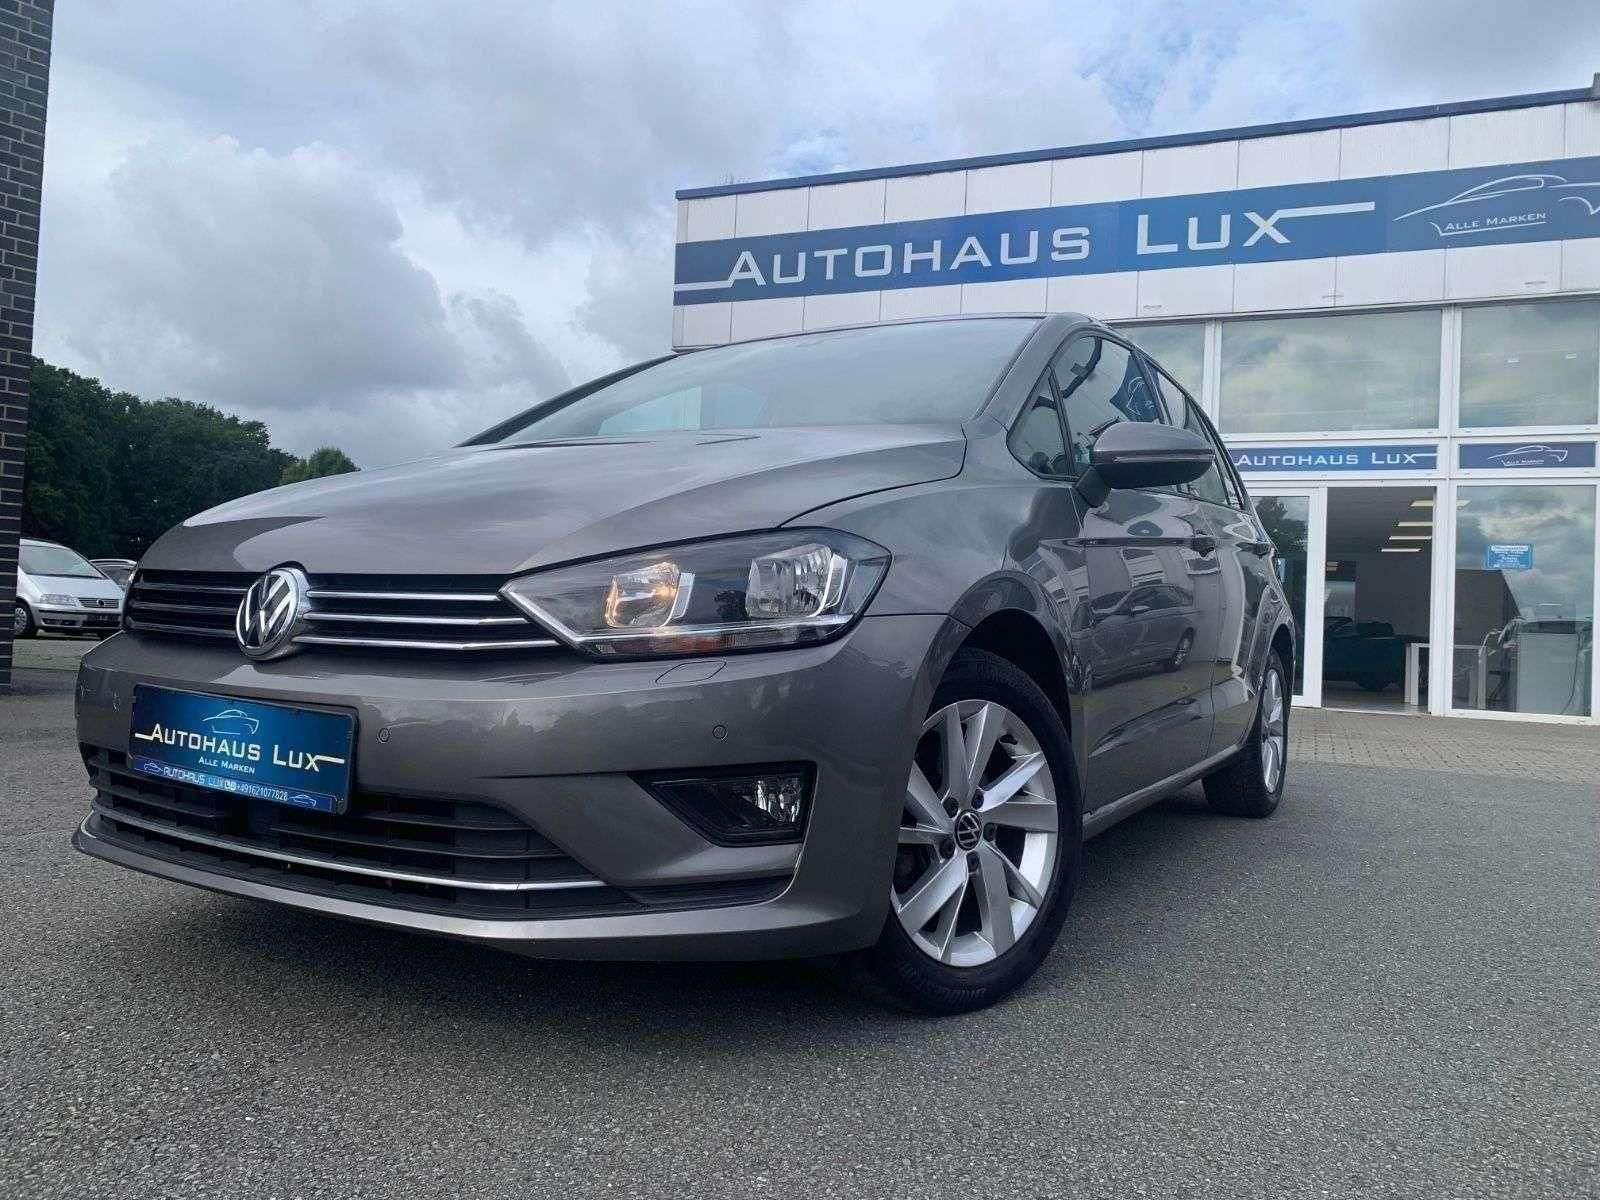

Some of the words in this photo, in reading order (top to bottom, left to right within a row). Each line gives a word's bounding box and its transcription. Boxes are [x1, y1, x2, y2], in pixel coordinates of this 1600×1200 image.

[1444, 220, 1479, 231] ALLE
[1486, 213, 1546, 226] MARKEN
[727, 226, 1091, 288] AUTOHAUS
[1136, 211, 1291, 255] LUX
[1235, 453, 1359, 466] AUTOHAUS
[1371, 452, 1417, 464] LUX
[150, 723, 261, 761] AUTOHAUS
[273, 744, 320, 772] LUX
[199, 756, 218, 767] ALLE
[221, 760, 256, 774] MARKEN
[163, 766, 206, 785] AUTOHAUS
